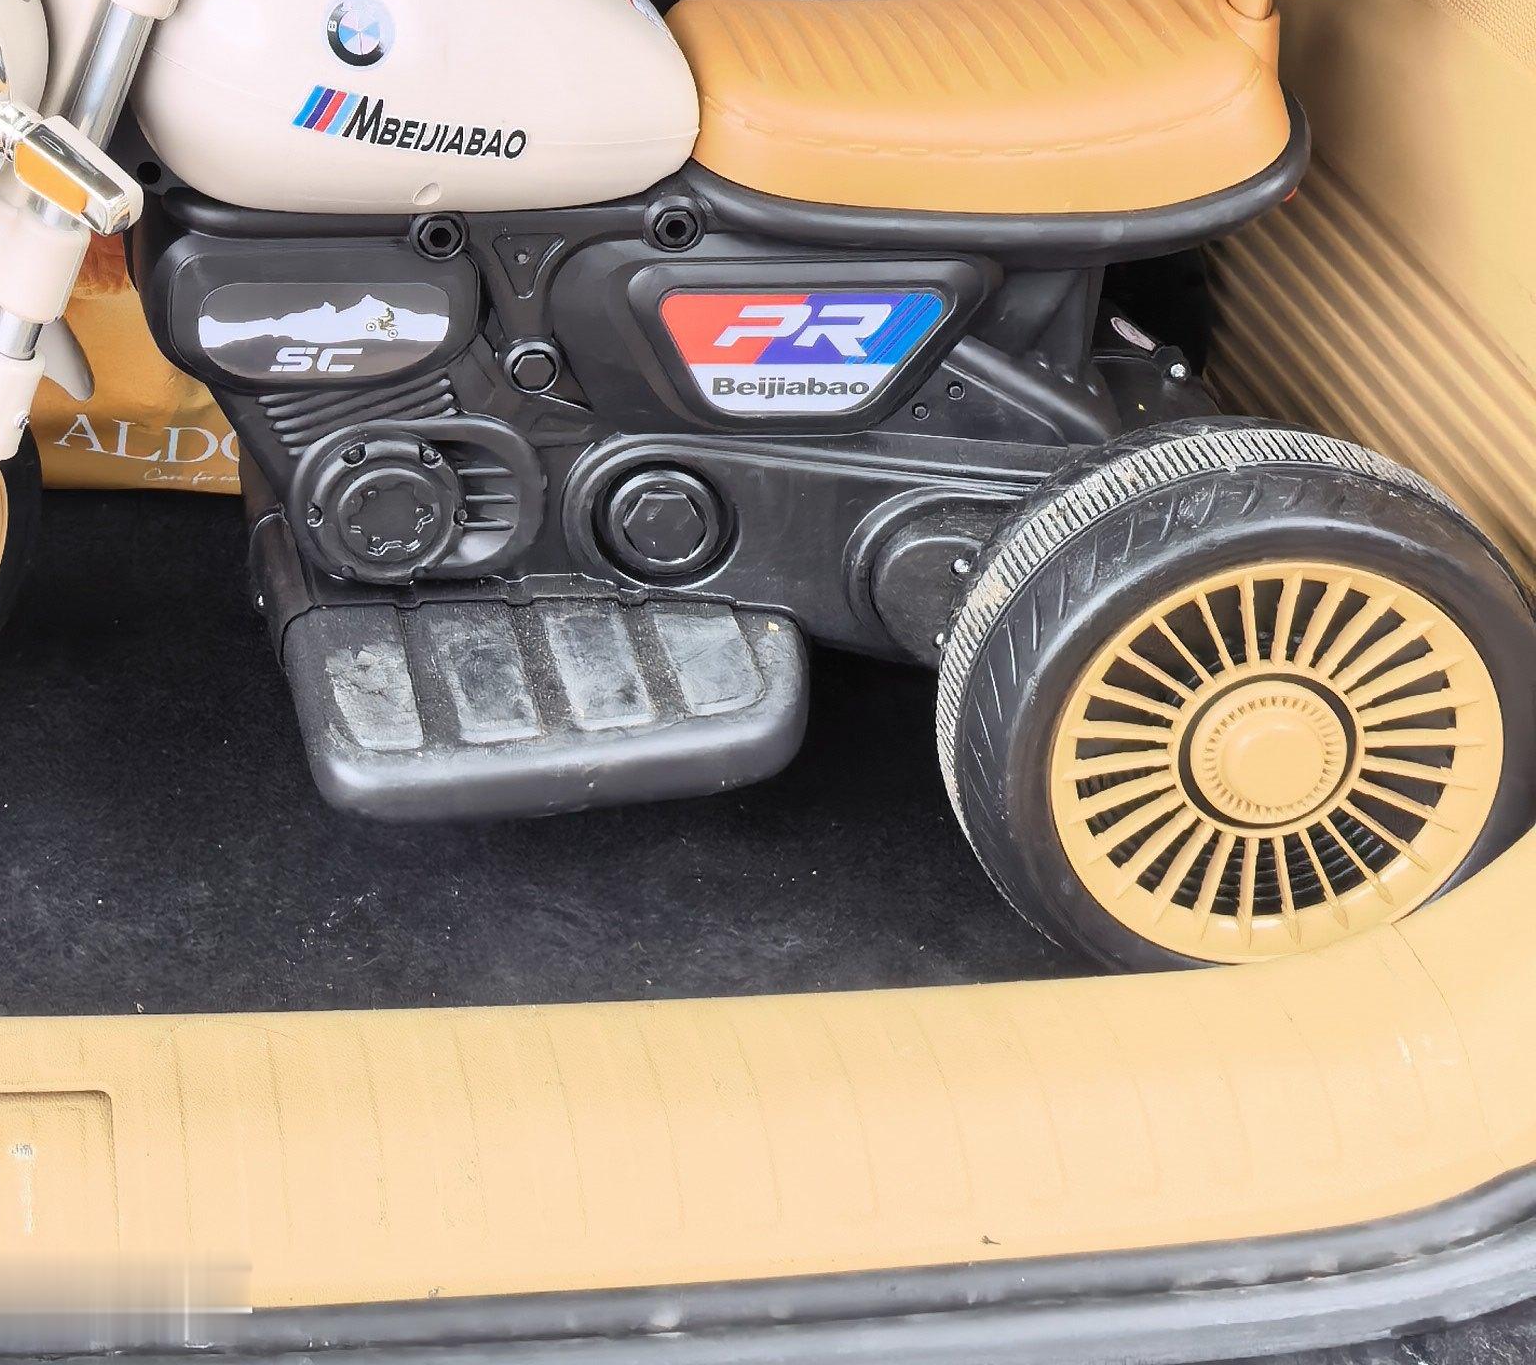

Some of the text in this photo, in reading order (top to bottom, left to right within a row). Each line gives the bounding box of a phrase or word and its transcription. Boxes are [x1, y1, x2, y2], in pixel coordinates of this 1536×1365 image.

[712, 304, 892, 357] PR
[269, 346, 364, 372] SC
[712, 376, 870, 399] Beijiabao
